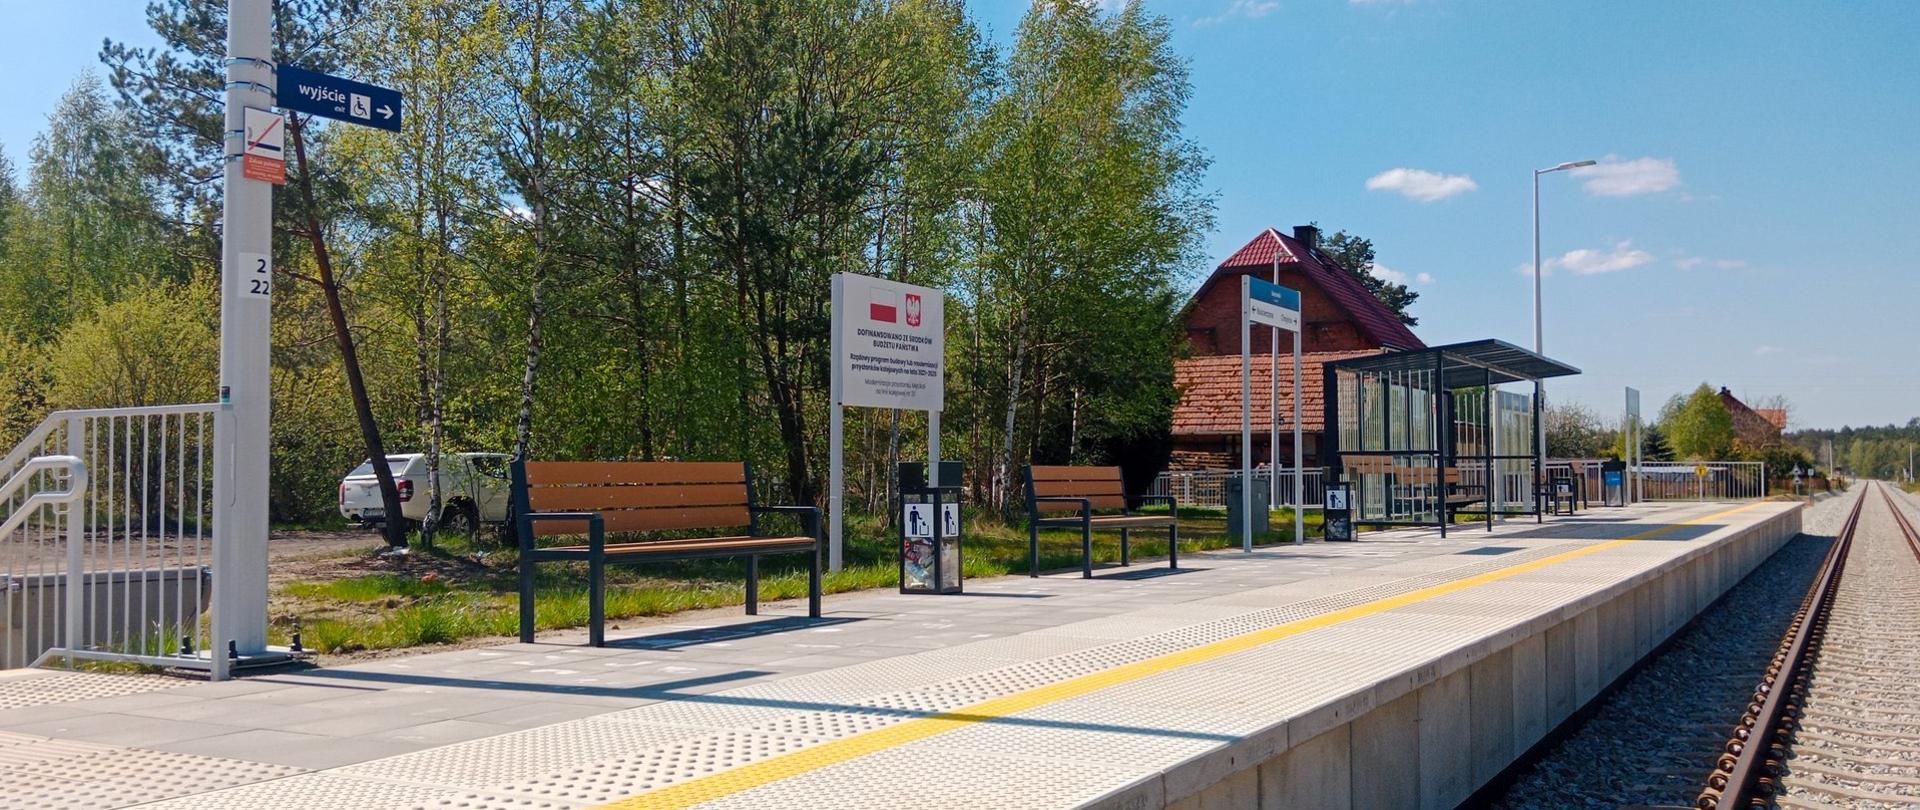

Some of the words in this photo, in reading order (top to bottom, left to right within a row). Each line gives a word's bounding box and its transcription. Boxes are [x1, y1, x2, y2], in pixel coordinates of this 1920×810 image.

[298, 84, 346, 103] wyjście
[256, 258, 266, 273] 2
[250, 279, 269, 295] 22
[857, 328, 902, 340] DOFINANSOWANO
[902, 334, 909, 342] ZE
[909, 334, 932, 345] ŚRODKÓW
[873, 339, 895, 350] BUDŻETU
[895, 341, 919, 352] PAŃSTWA
